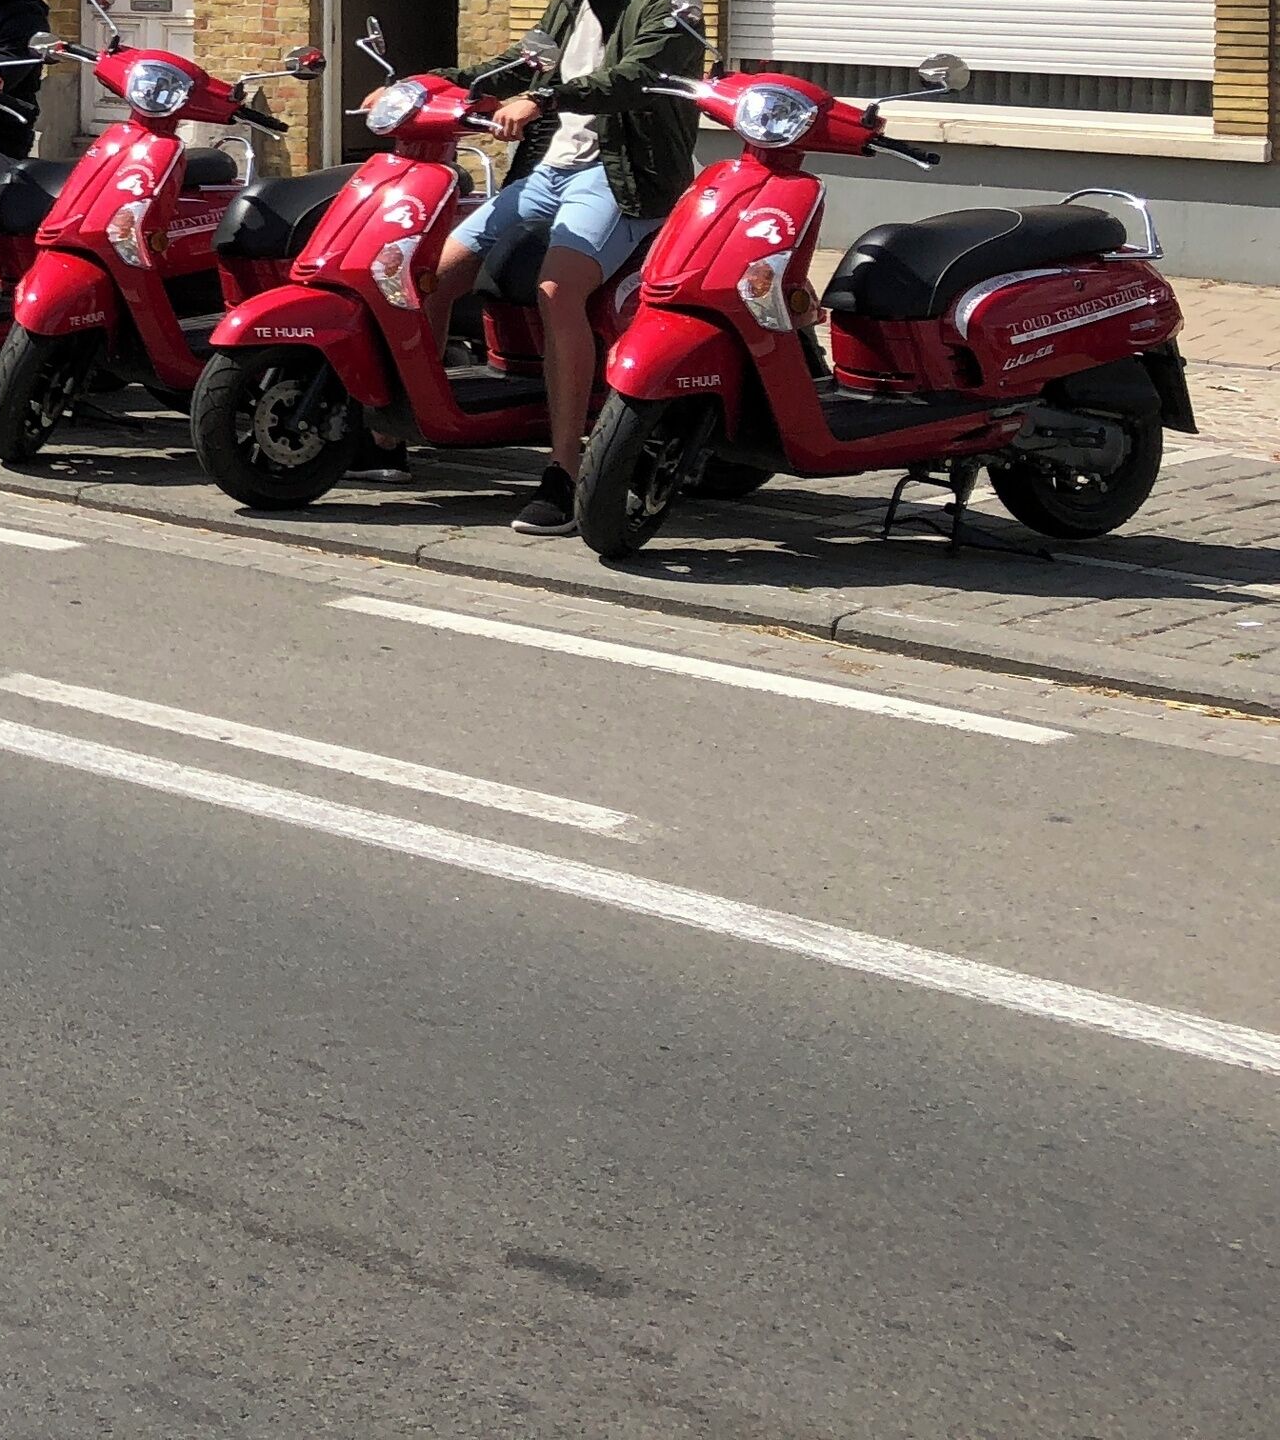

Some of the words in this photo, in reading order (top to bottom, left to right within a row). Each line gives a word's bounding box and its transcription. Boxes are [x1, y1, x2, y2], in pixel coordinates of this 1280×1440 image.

[1022, 314, 1052, 332] OUD
[1054, 284, 1147, 321] GEMEENTEHUIS
[253, 327, 272, 338] TE
[274, 327, 315, 338] HUUR
[675, 376, 690, 388] TE
[691, 374, 721, 388] HUUR
